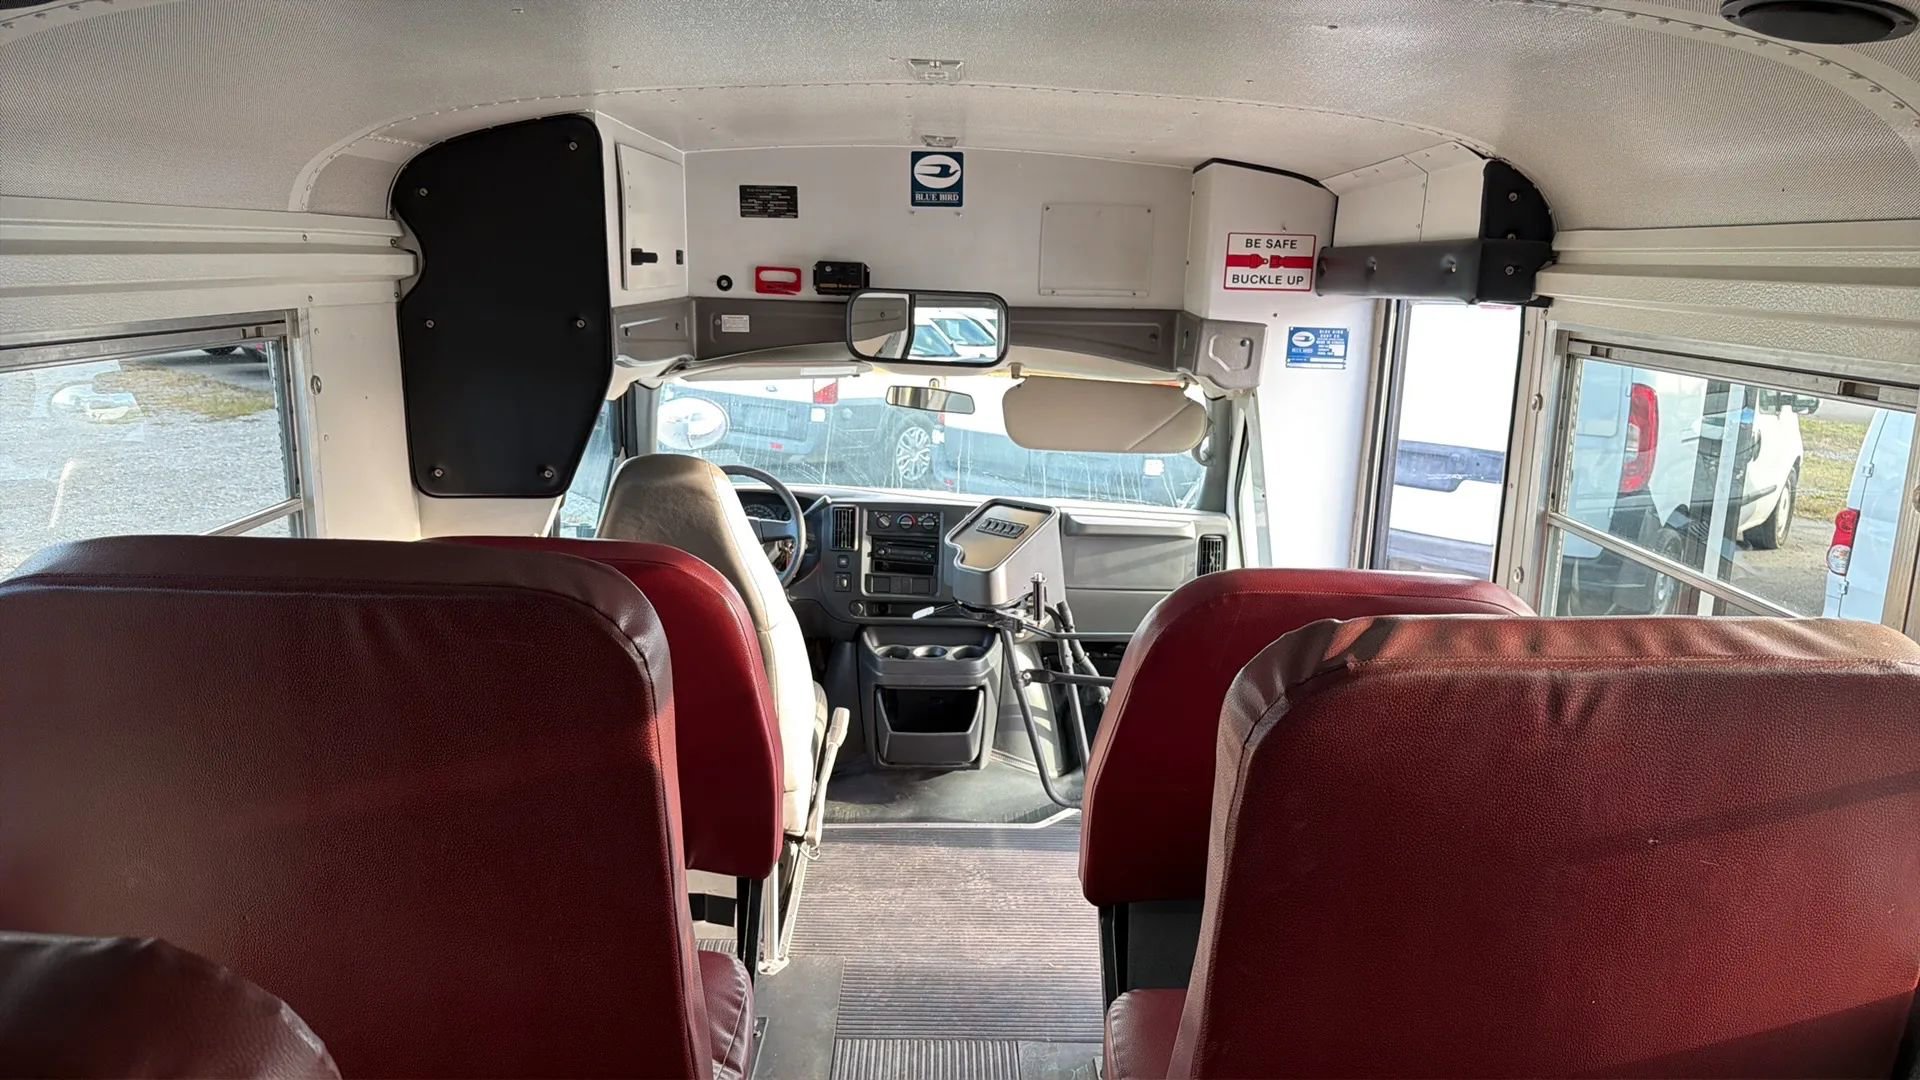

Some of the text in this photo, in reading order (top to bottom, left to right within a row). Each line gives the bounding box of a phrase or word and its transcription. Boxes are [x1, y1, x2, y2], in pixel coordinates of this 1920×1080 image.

[915, 193, 960, 201] BLUE BIRD
[1245, 238, 1298, 250] BE SAFE
[1232, 274, 1304, 285] BUCKLE UP
